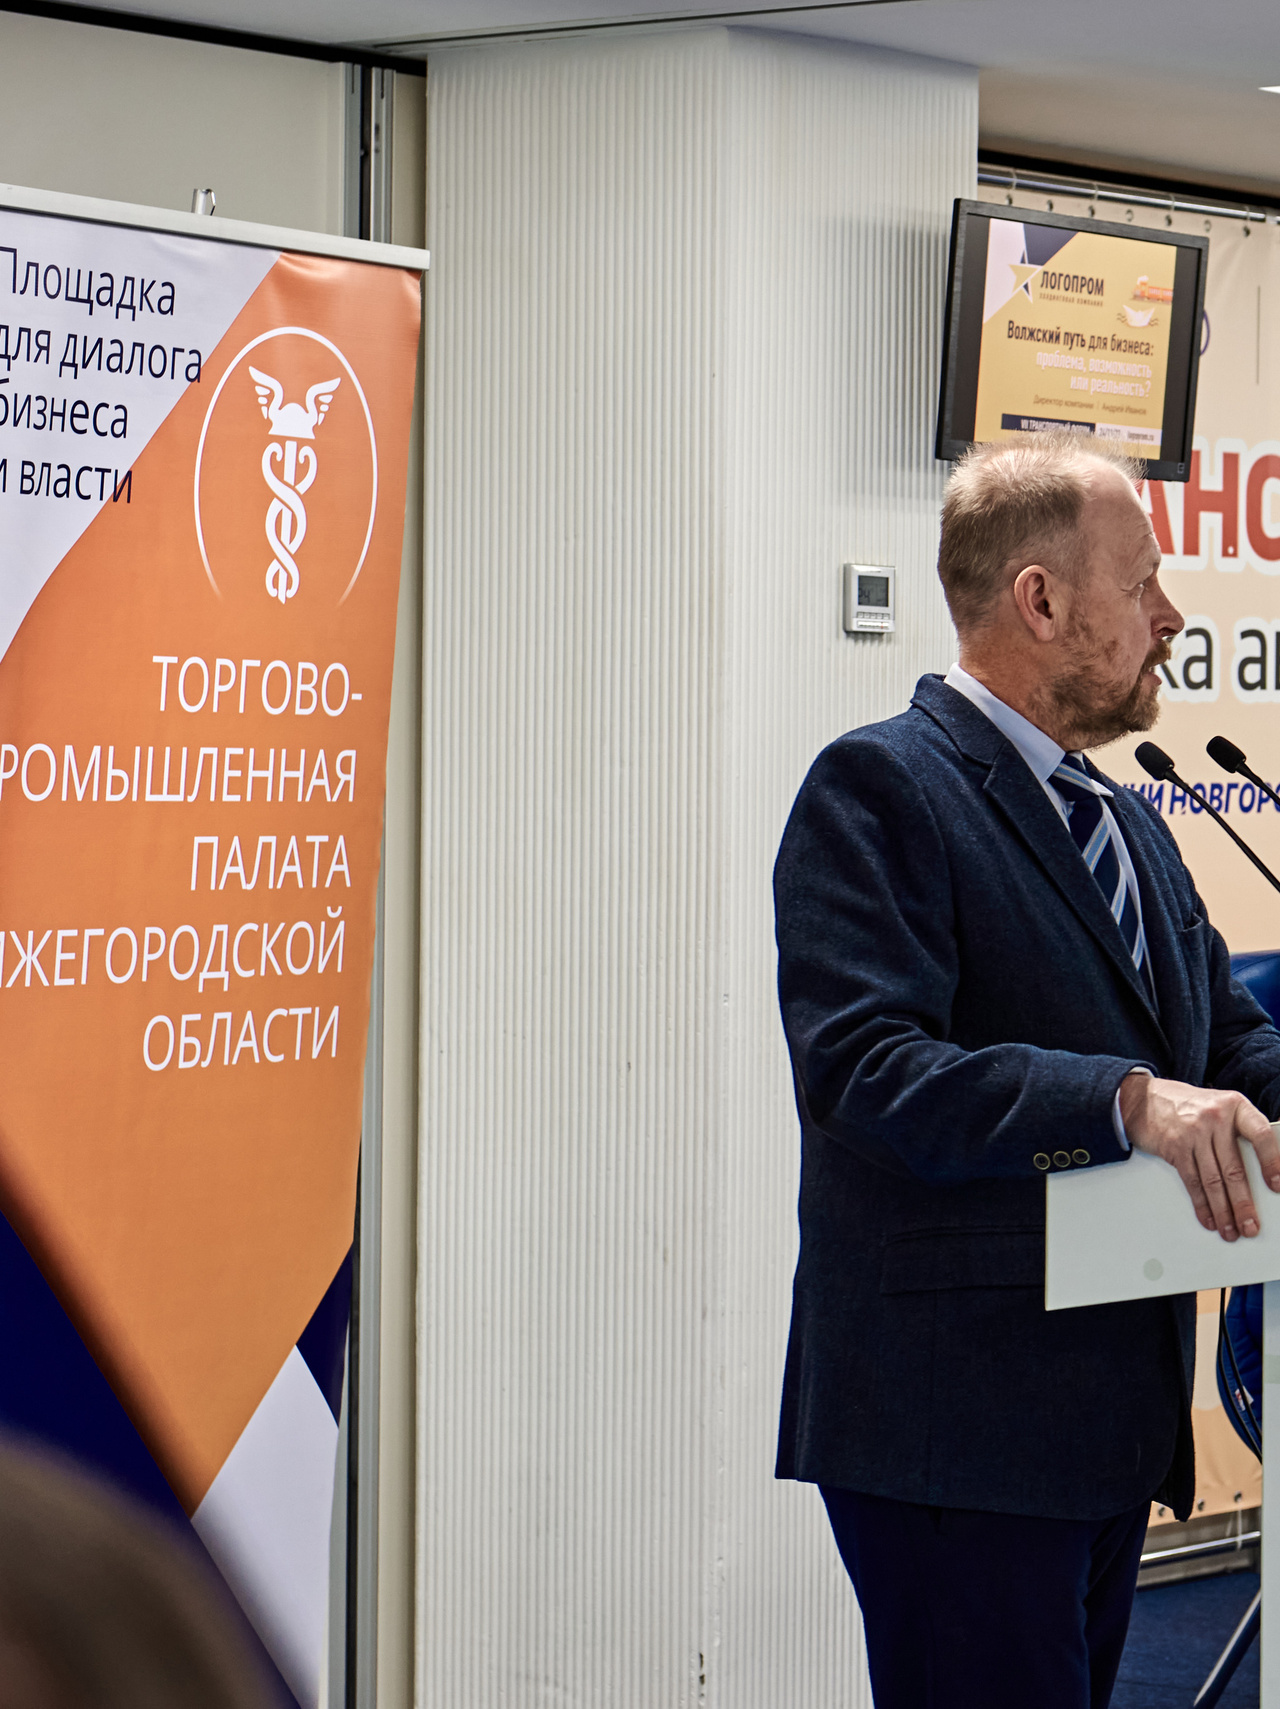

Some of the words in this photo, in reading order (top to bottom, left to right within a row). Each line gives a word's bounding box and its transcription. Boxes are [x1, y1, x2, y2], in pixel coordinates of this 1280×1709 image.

[0, 246, 176, 321] Площадка
[1040, 270, 1104, 296] ЛОГОПРОМ
[59, 333, 202, 383] диалога
[1007, 320, 1060, 342] Волжский
[1063, 331, 1086, 349] путь
[1088, 335, 1108, 352] для
[1111, 334, 1154, 356] бизнеса:
[1036, 350, 1087, 373] проблема,
[1089, 357, 1152, 379] возможность
[1070, 374, 1088, 390] или
[1090, 378, 1152, 398] реальность?
[20, 458, 133, 503] власти
[152, 655, 363, 717] ТОРГОВО-
[190, 835, 352, 891] ПАЛАТА
[142, 1005, 340, 1072] ОБЛАСТИ
